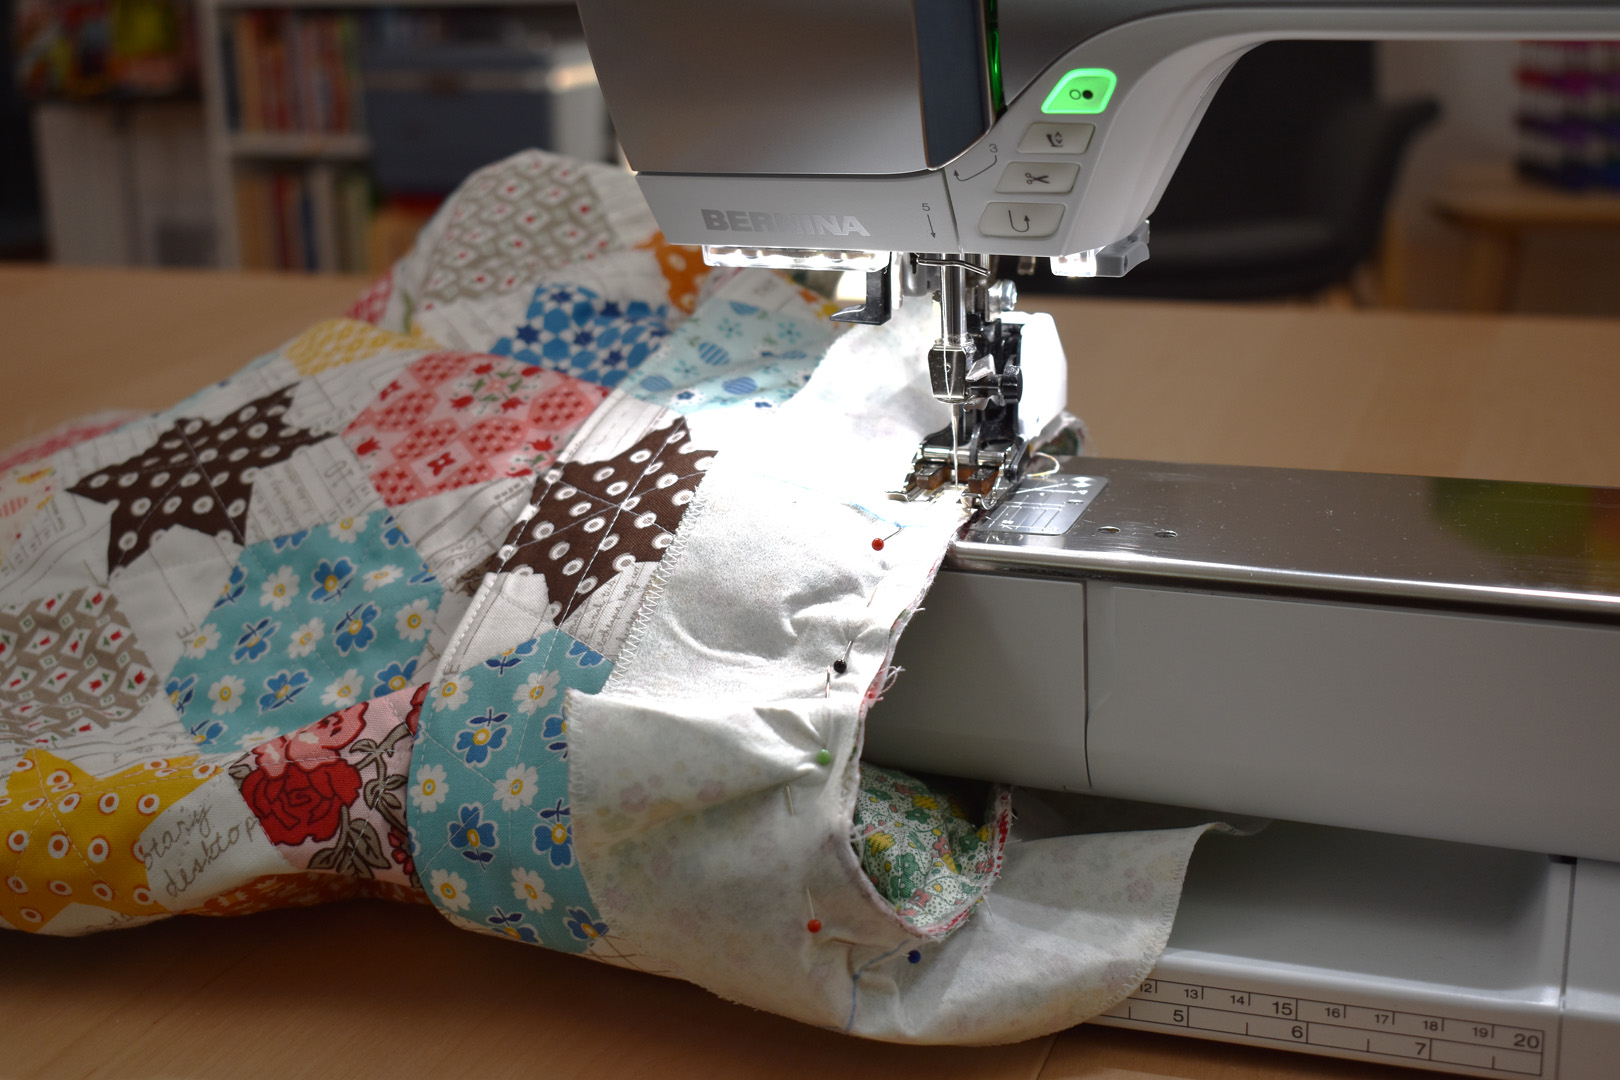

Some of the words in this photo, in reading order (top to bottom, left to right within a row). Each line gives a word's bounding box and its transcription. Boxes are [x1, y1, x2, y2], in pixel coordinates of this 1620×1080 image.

[988, 143, 999, 154] 3
[921, 202, 931, 212] 5
[700, 208, 872, 237] BERNINA
[1140, 983, 1153, 994] 12
[1183, 988, 1199, 1000] 13
[1229, 994, 1245, 1006] 14
[1272, 1001, 1293, 1016] 15
[1325, 1007, 1341, 1018] 16
[1374, 1013, 1390, 1025] 17
[1422, 1020, 1439, 1032] 18
[1472, 1027, 1488, 1038] 19
[1513, 1033, 1540, 1049] 20
[1172, 1009, 1184, 1023] 5
[1291, 1025, 1304, 1039] 6
[1414, 1042, 1427, 1056] 7
